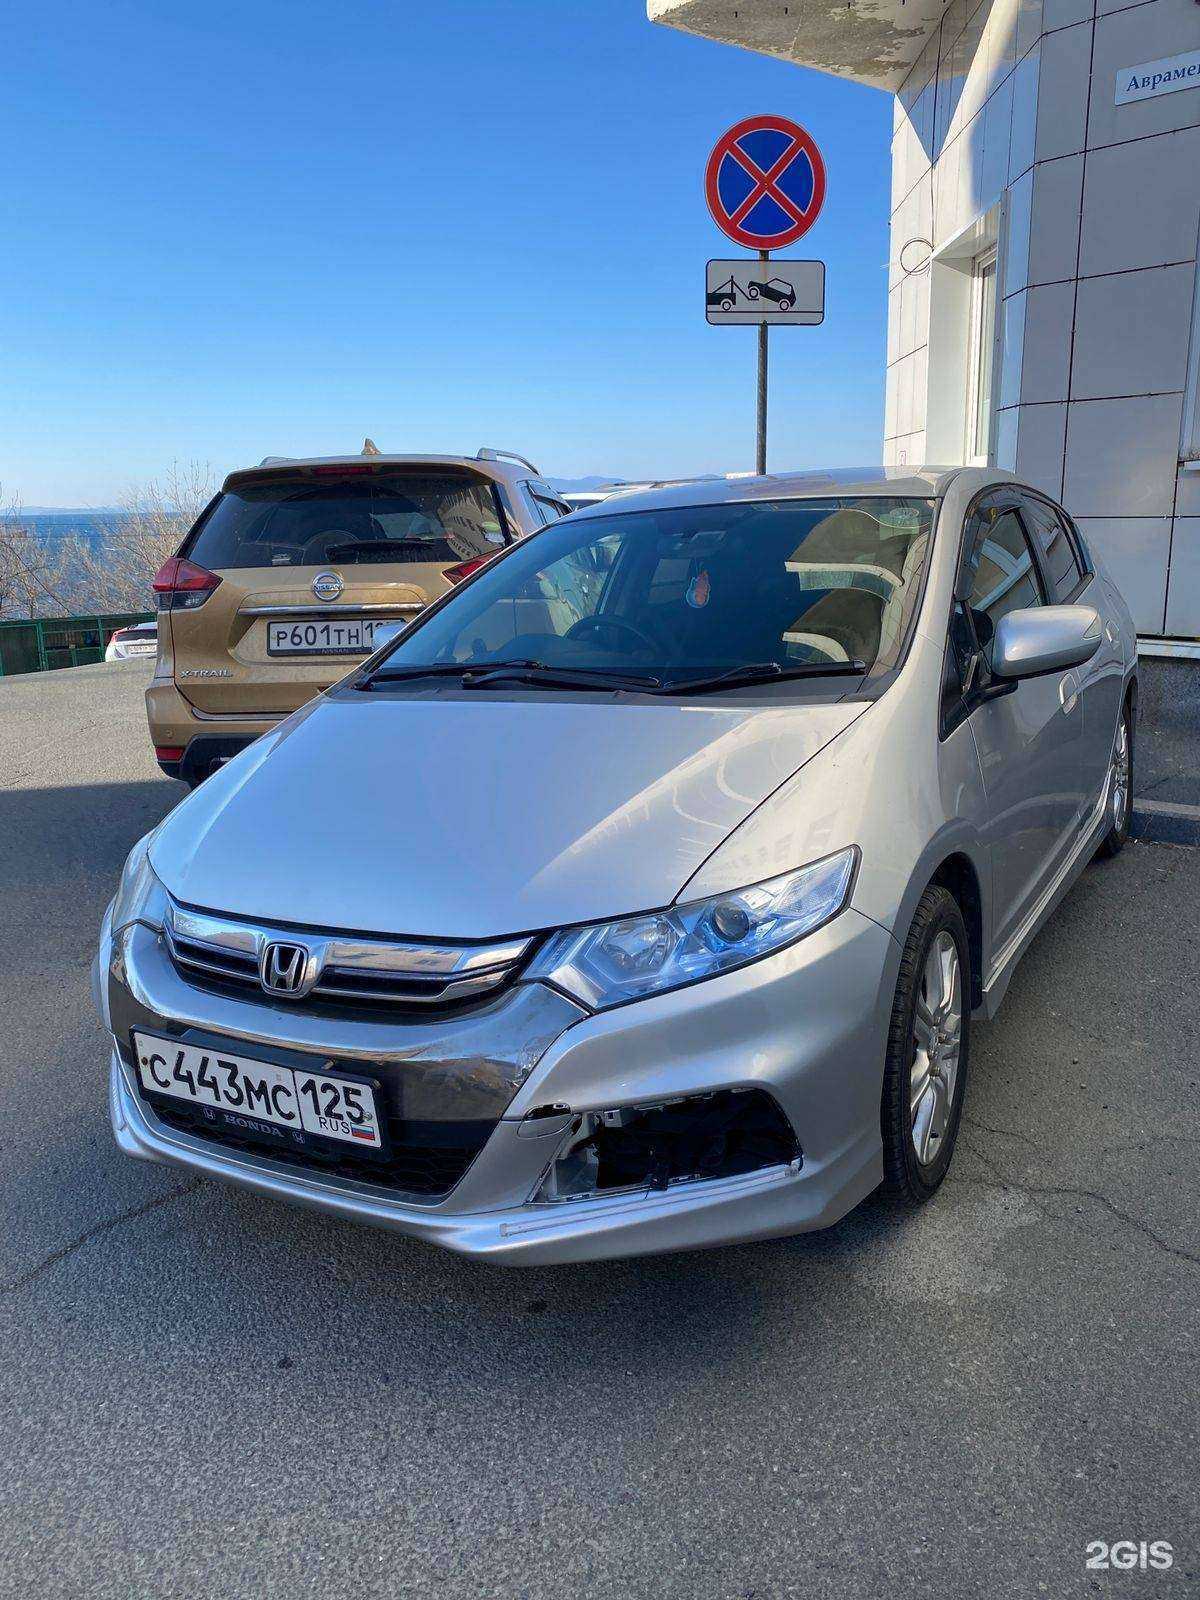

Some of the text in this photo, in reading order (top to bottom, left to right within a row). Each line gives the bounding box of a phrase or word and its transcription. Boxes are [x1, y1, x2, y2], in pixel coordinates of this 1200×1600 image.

[313, 583, 342, 591] NISSAN
[301, 1079, 364, 1124] 125
[223, 1114, 285, 1138] HONDA
[319, 1117, 350, 1135] RUS
